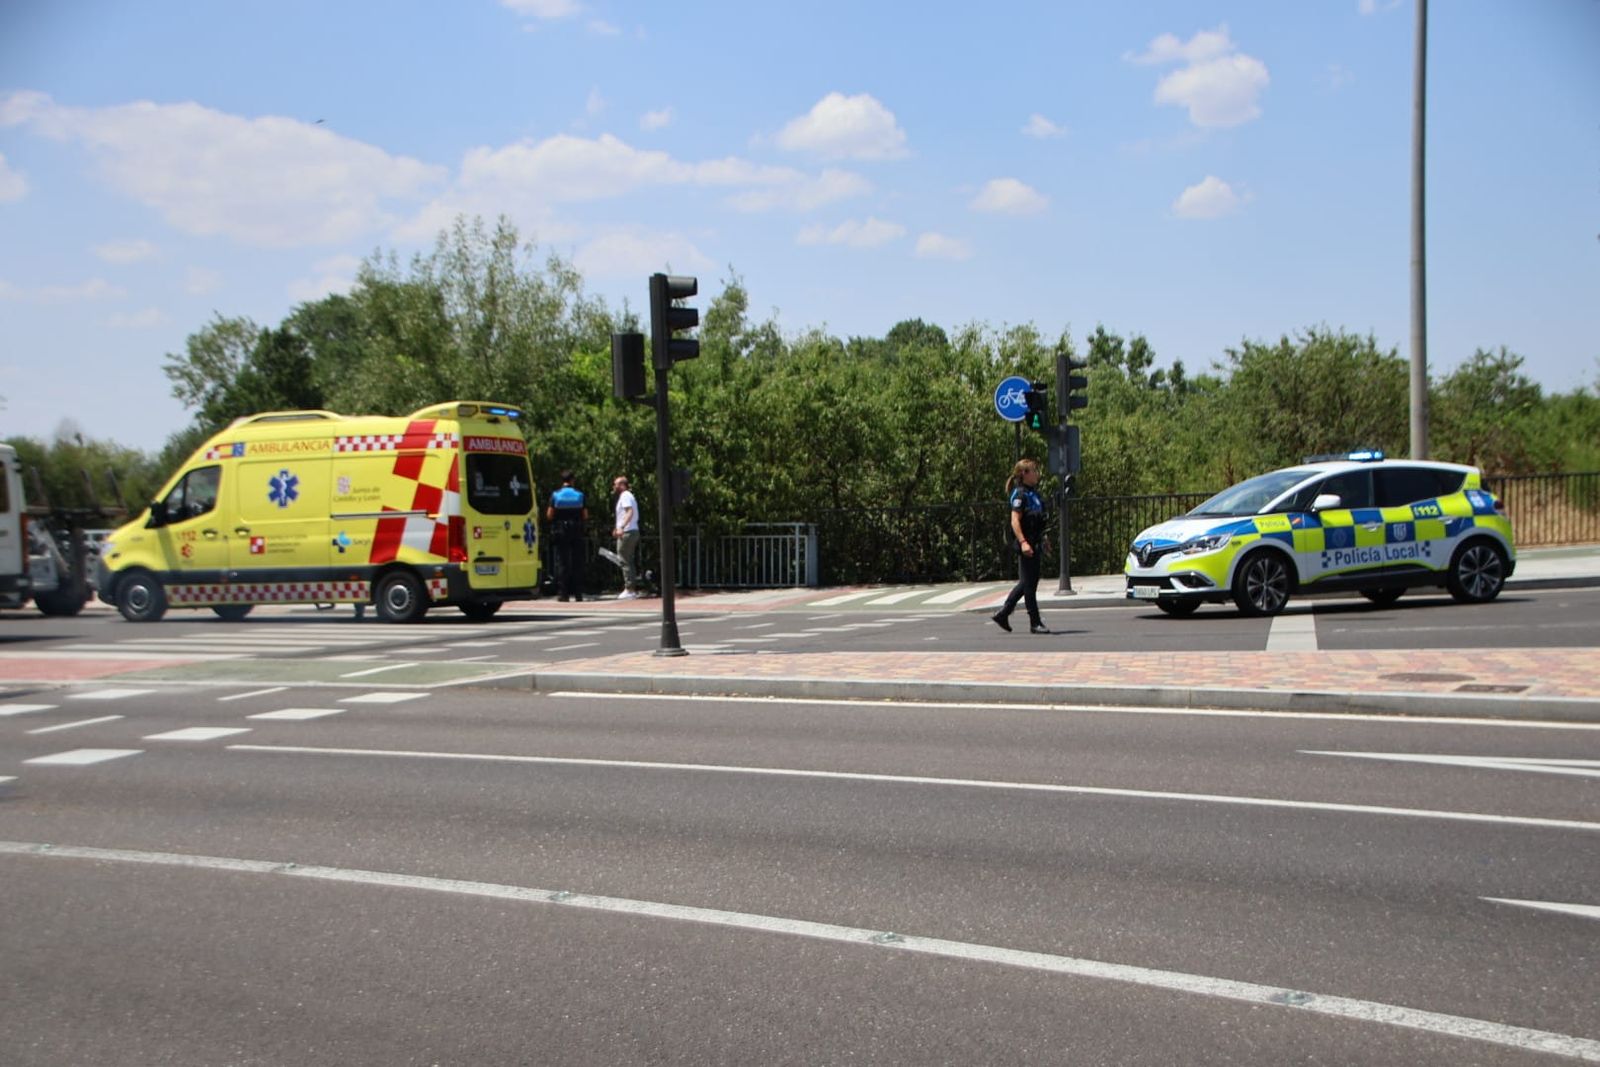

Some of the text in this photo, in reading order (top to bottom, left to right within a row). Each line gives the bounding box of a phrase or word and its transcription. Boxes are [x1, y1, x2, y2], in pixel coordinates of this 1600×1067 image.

[249, 440, 331, 454] AMBULANCIA
[468, 438, 525, 453] AMBULANCIA
[1418, 504, 1438, 516] 112
[180, 531, 197, 541] 112
[1334, 543, 1420, 565] Policía Local
